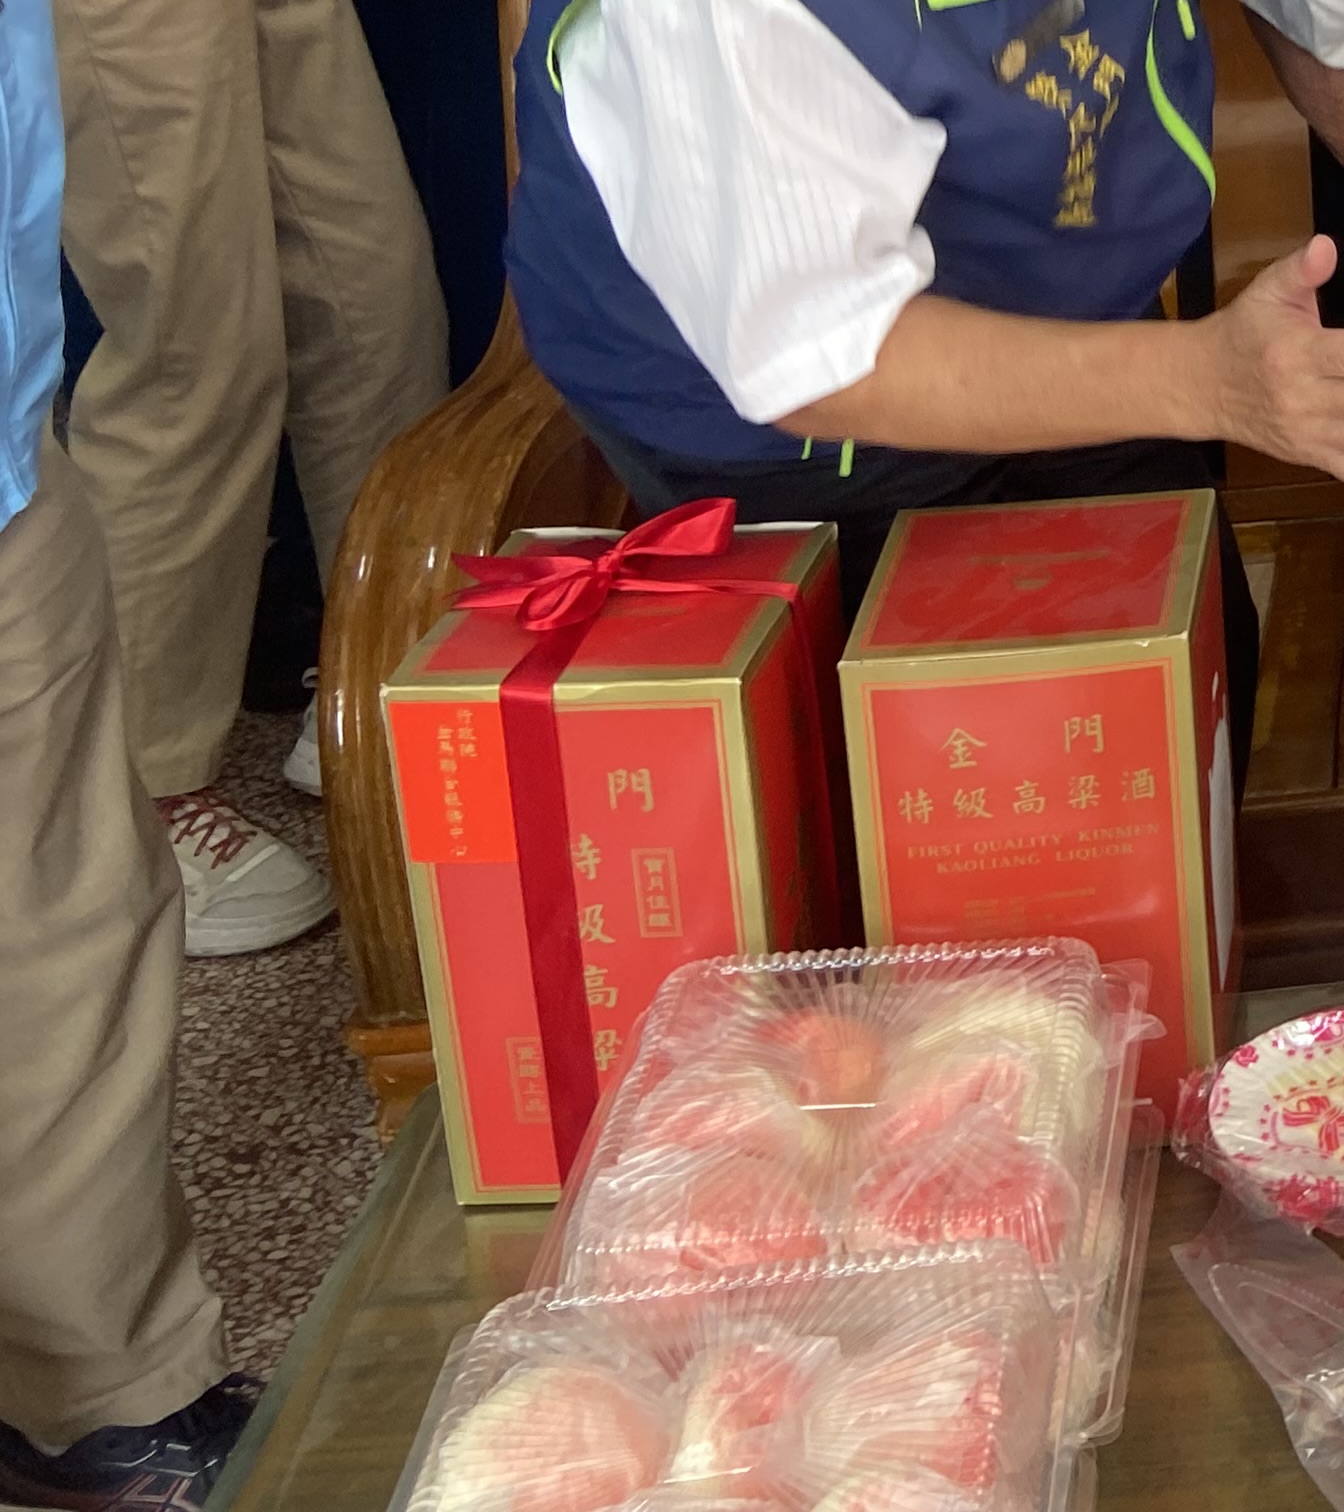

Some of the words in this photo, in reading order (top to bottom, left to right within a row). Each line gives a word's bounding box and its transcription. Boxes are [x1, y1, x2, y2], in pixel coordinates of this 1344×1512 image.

[939, 713, 1106, 770] 金門
[898, 767, 1157, 825] 特級高粱酒
[908, 842, 964, 859] FIRST
[973, 833, 1064, 855] QUALITY
[1078, 822, 1162, 842] KINMEN
[936, 854, 1042, 875] KAOLIANG
[1056, 843, 1135, 863] LIQUOR
